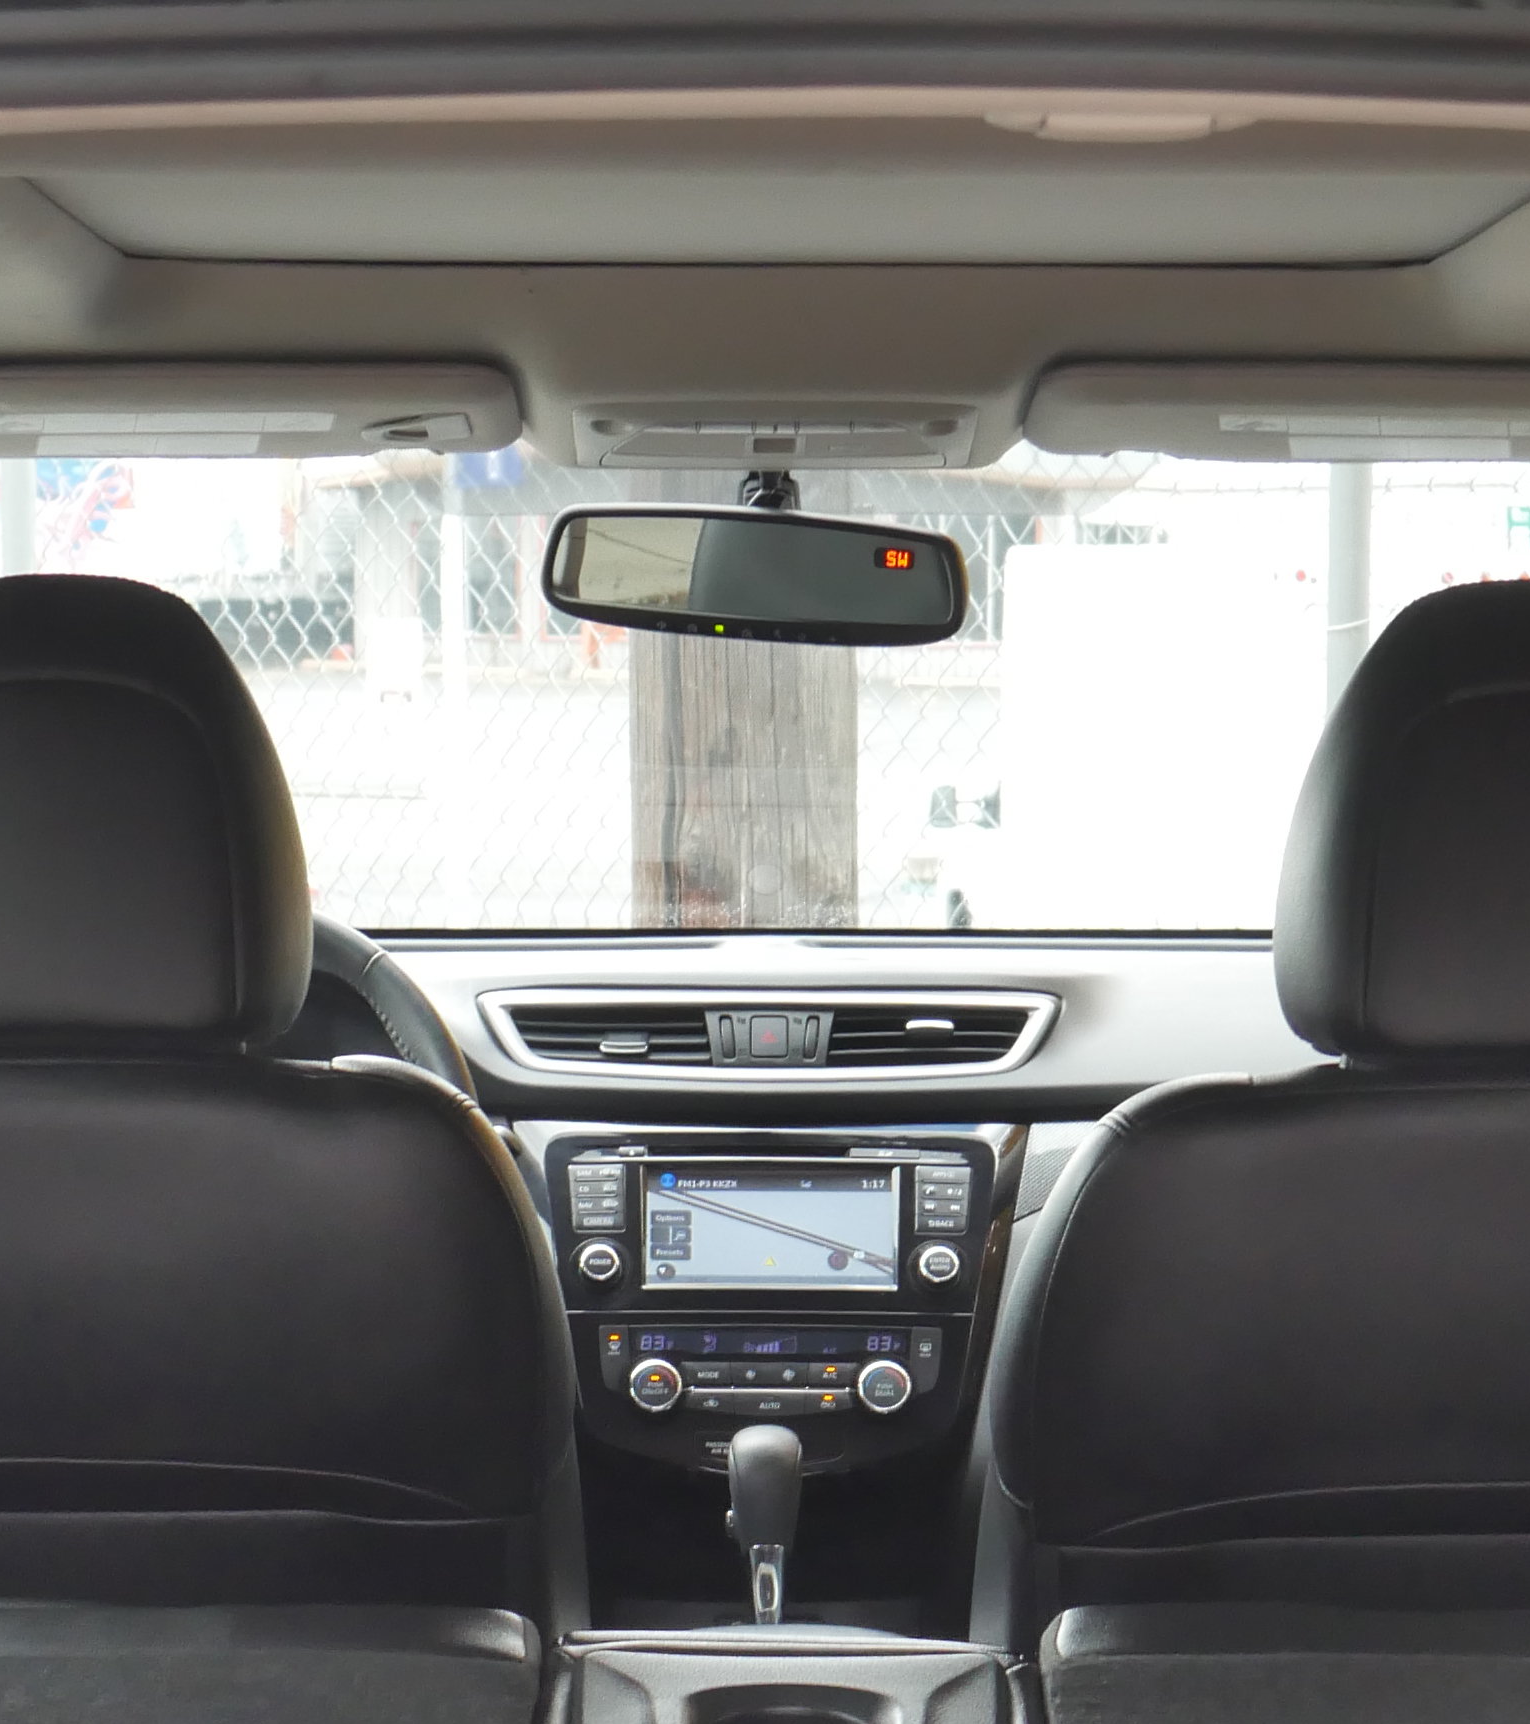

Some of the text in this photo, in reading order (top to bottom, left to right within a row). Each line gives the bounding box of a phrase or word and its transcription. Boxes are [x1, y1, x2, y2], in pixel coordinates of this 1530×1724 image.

[886, 550, 908, 568] SW
[861, 1179, 885, 1189] 1:17
[654, 1214, 686, 1223] Options
[697, 1370, 720, 1379] MODE
[759, 1402, 781, 1410] AUTO
